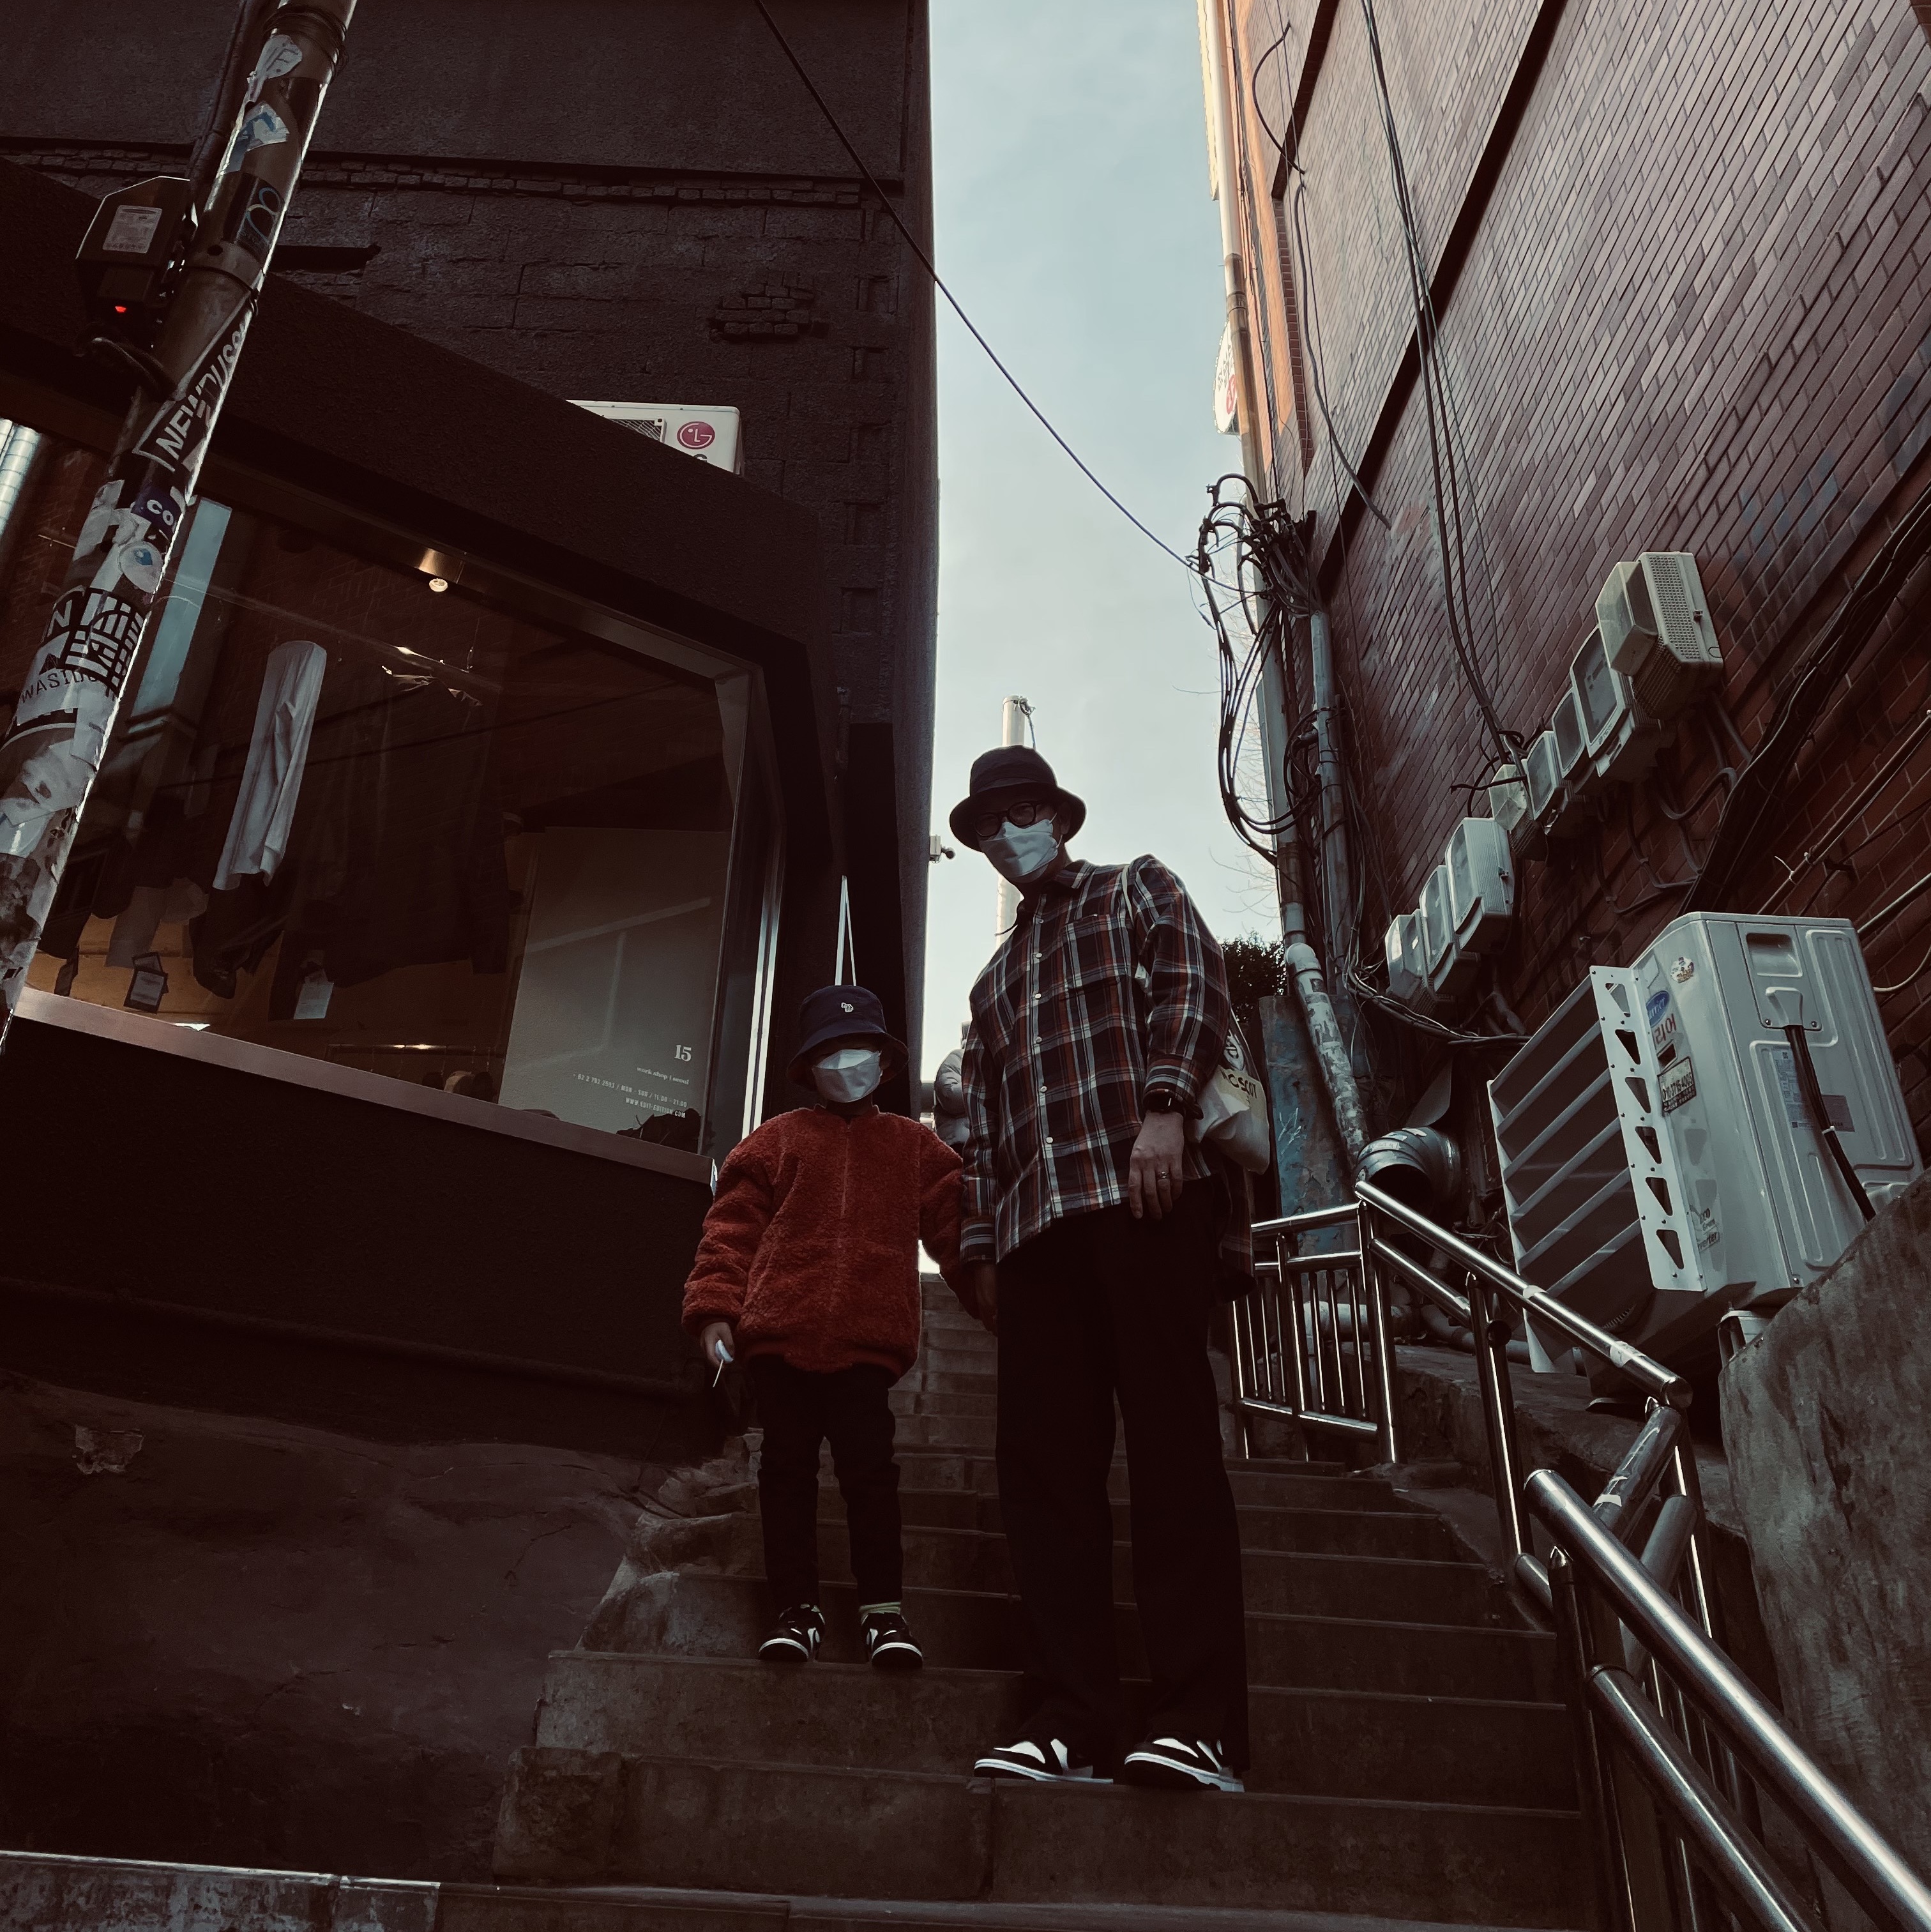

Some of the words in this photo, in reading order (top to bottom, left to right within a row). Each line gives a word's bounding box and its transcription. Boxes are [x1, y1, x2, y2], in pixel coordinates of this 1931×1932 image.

[679, 422, 713, 448] LG
[674, 1044, 692, 1062] 15
[653, 1069, 668, 1081] shop
